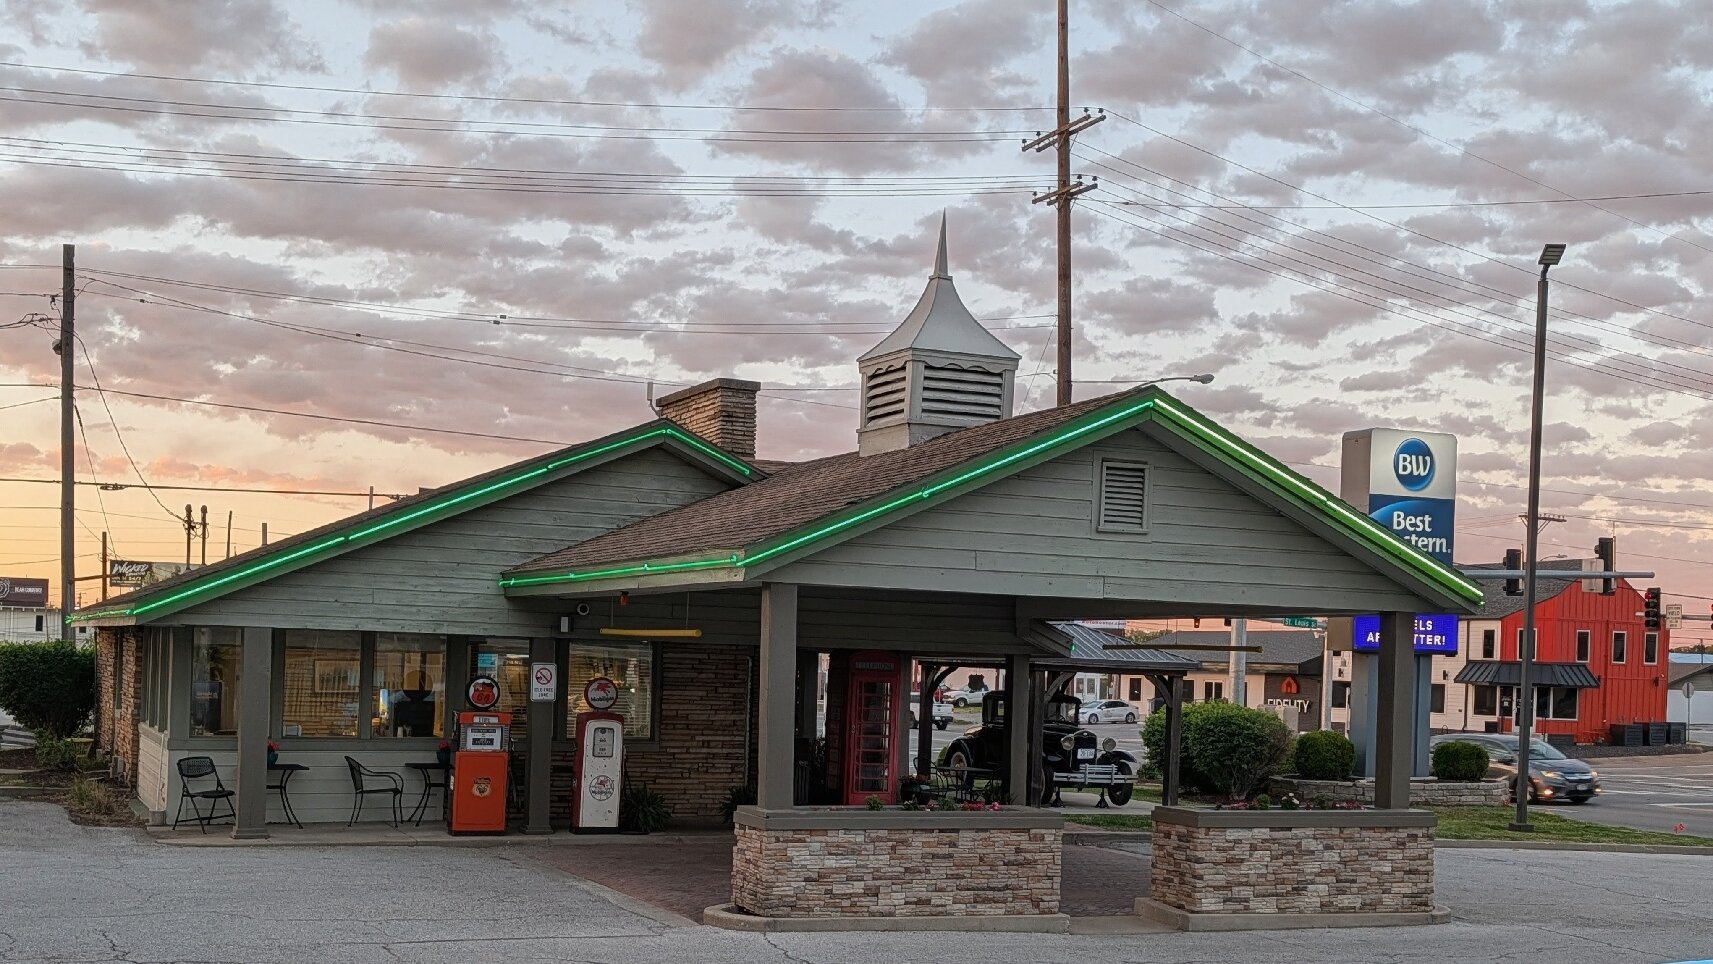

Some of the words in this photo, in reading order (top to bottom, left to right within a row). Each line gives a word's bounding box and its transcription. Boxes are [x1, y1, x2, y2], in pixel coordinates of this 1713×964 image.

[1398, 453, 1431, 476] BW
[1392, 511, 1433, 532] Best
[1294, 618, 1309, 627] Louis
